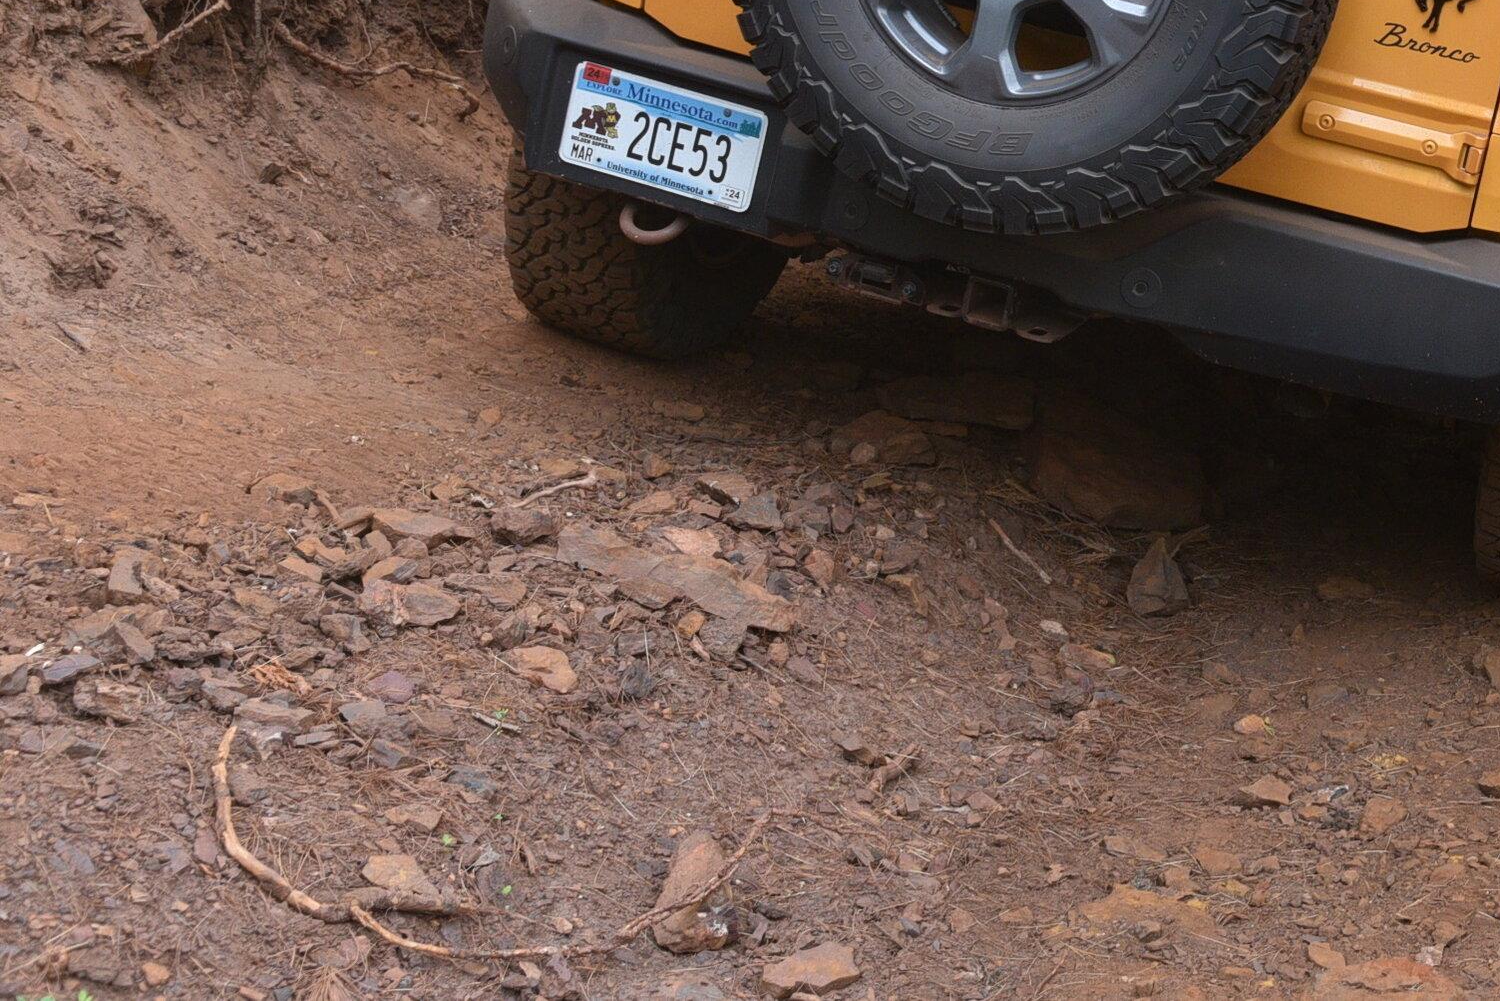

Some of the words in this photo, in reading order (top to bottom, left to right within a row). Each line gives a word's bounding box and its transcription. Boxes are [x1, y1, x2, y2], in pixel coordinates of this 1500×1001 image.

[1373, 22, 1480, 63] Bronco
[587, 67, 601, 78] 24
[627, 83, 738, 130] Minnesota.com
[570, 143, 593, 162] MAR
[627, 111, 732, 184] 2CE53
[606, 160, 648, 180] University
[649, 173, 660, 183] of
[660, 176, 704, 196] Minnesota
[728, 189, 741, 200] 24
